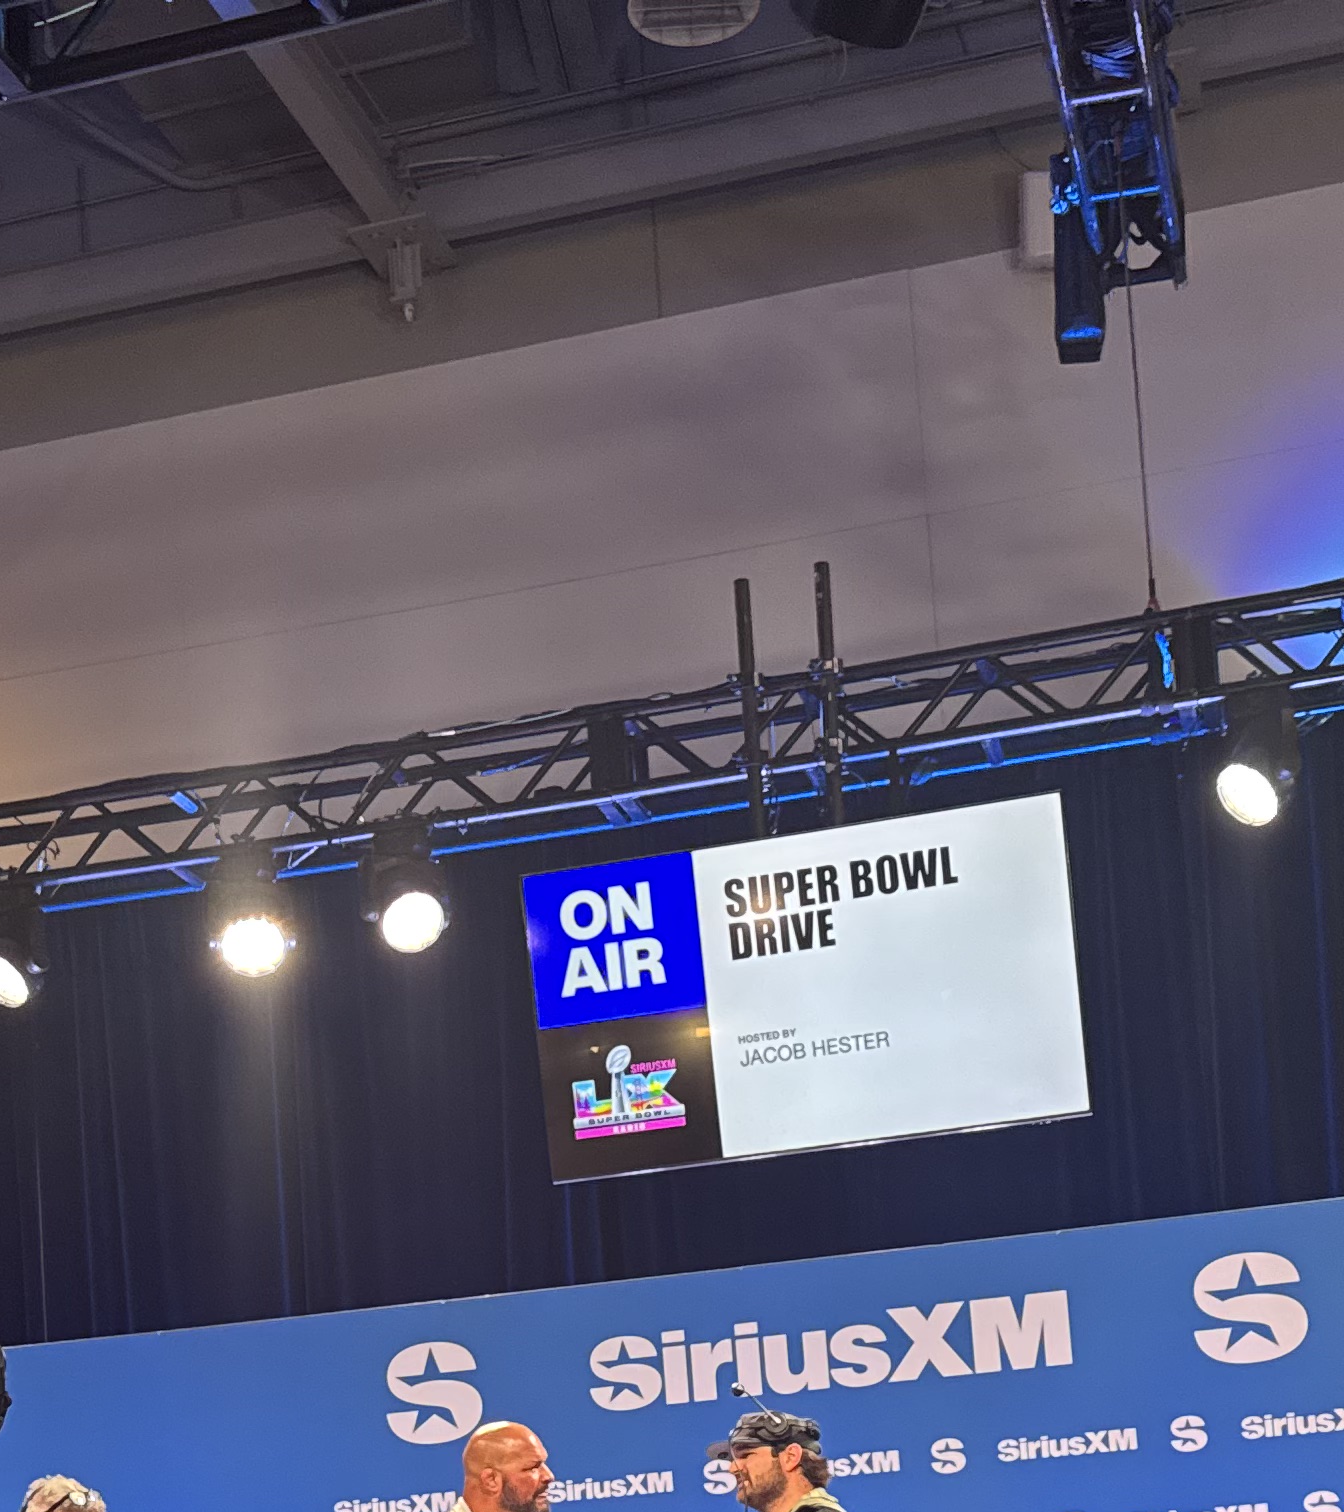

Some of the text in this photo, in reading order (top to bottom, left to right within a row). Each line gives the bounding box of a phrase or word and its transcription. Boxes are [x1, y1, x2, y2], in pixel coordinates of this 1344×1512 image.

[724, 846, 958, 918] SUPER BOWL
[560, 882, 654, 940] ON
[729, 909, 836, 960] DRIVE
[561, 937, 667, 998] AIR
[738, 1028, 797, 1045] HOSTED BY
[740, 1031, 890, 1068] JACOB HESTER
[630, 1058, 677, 1074] SIRIUSXM
[588, 1109, 671, 1125] SUPER BOWL
[590, 1289, 1073, 1411] SiriusXM
[545, 1471, 674, 1503] SiriusXM
[998, 1428, 1138, 1461] SiriusXM
